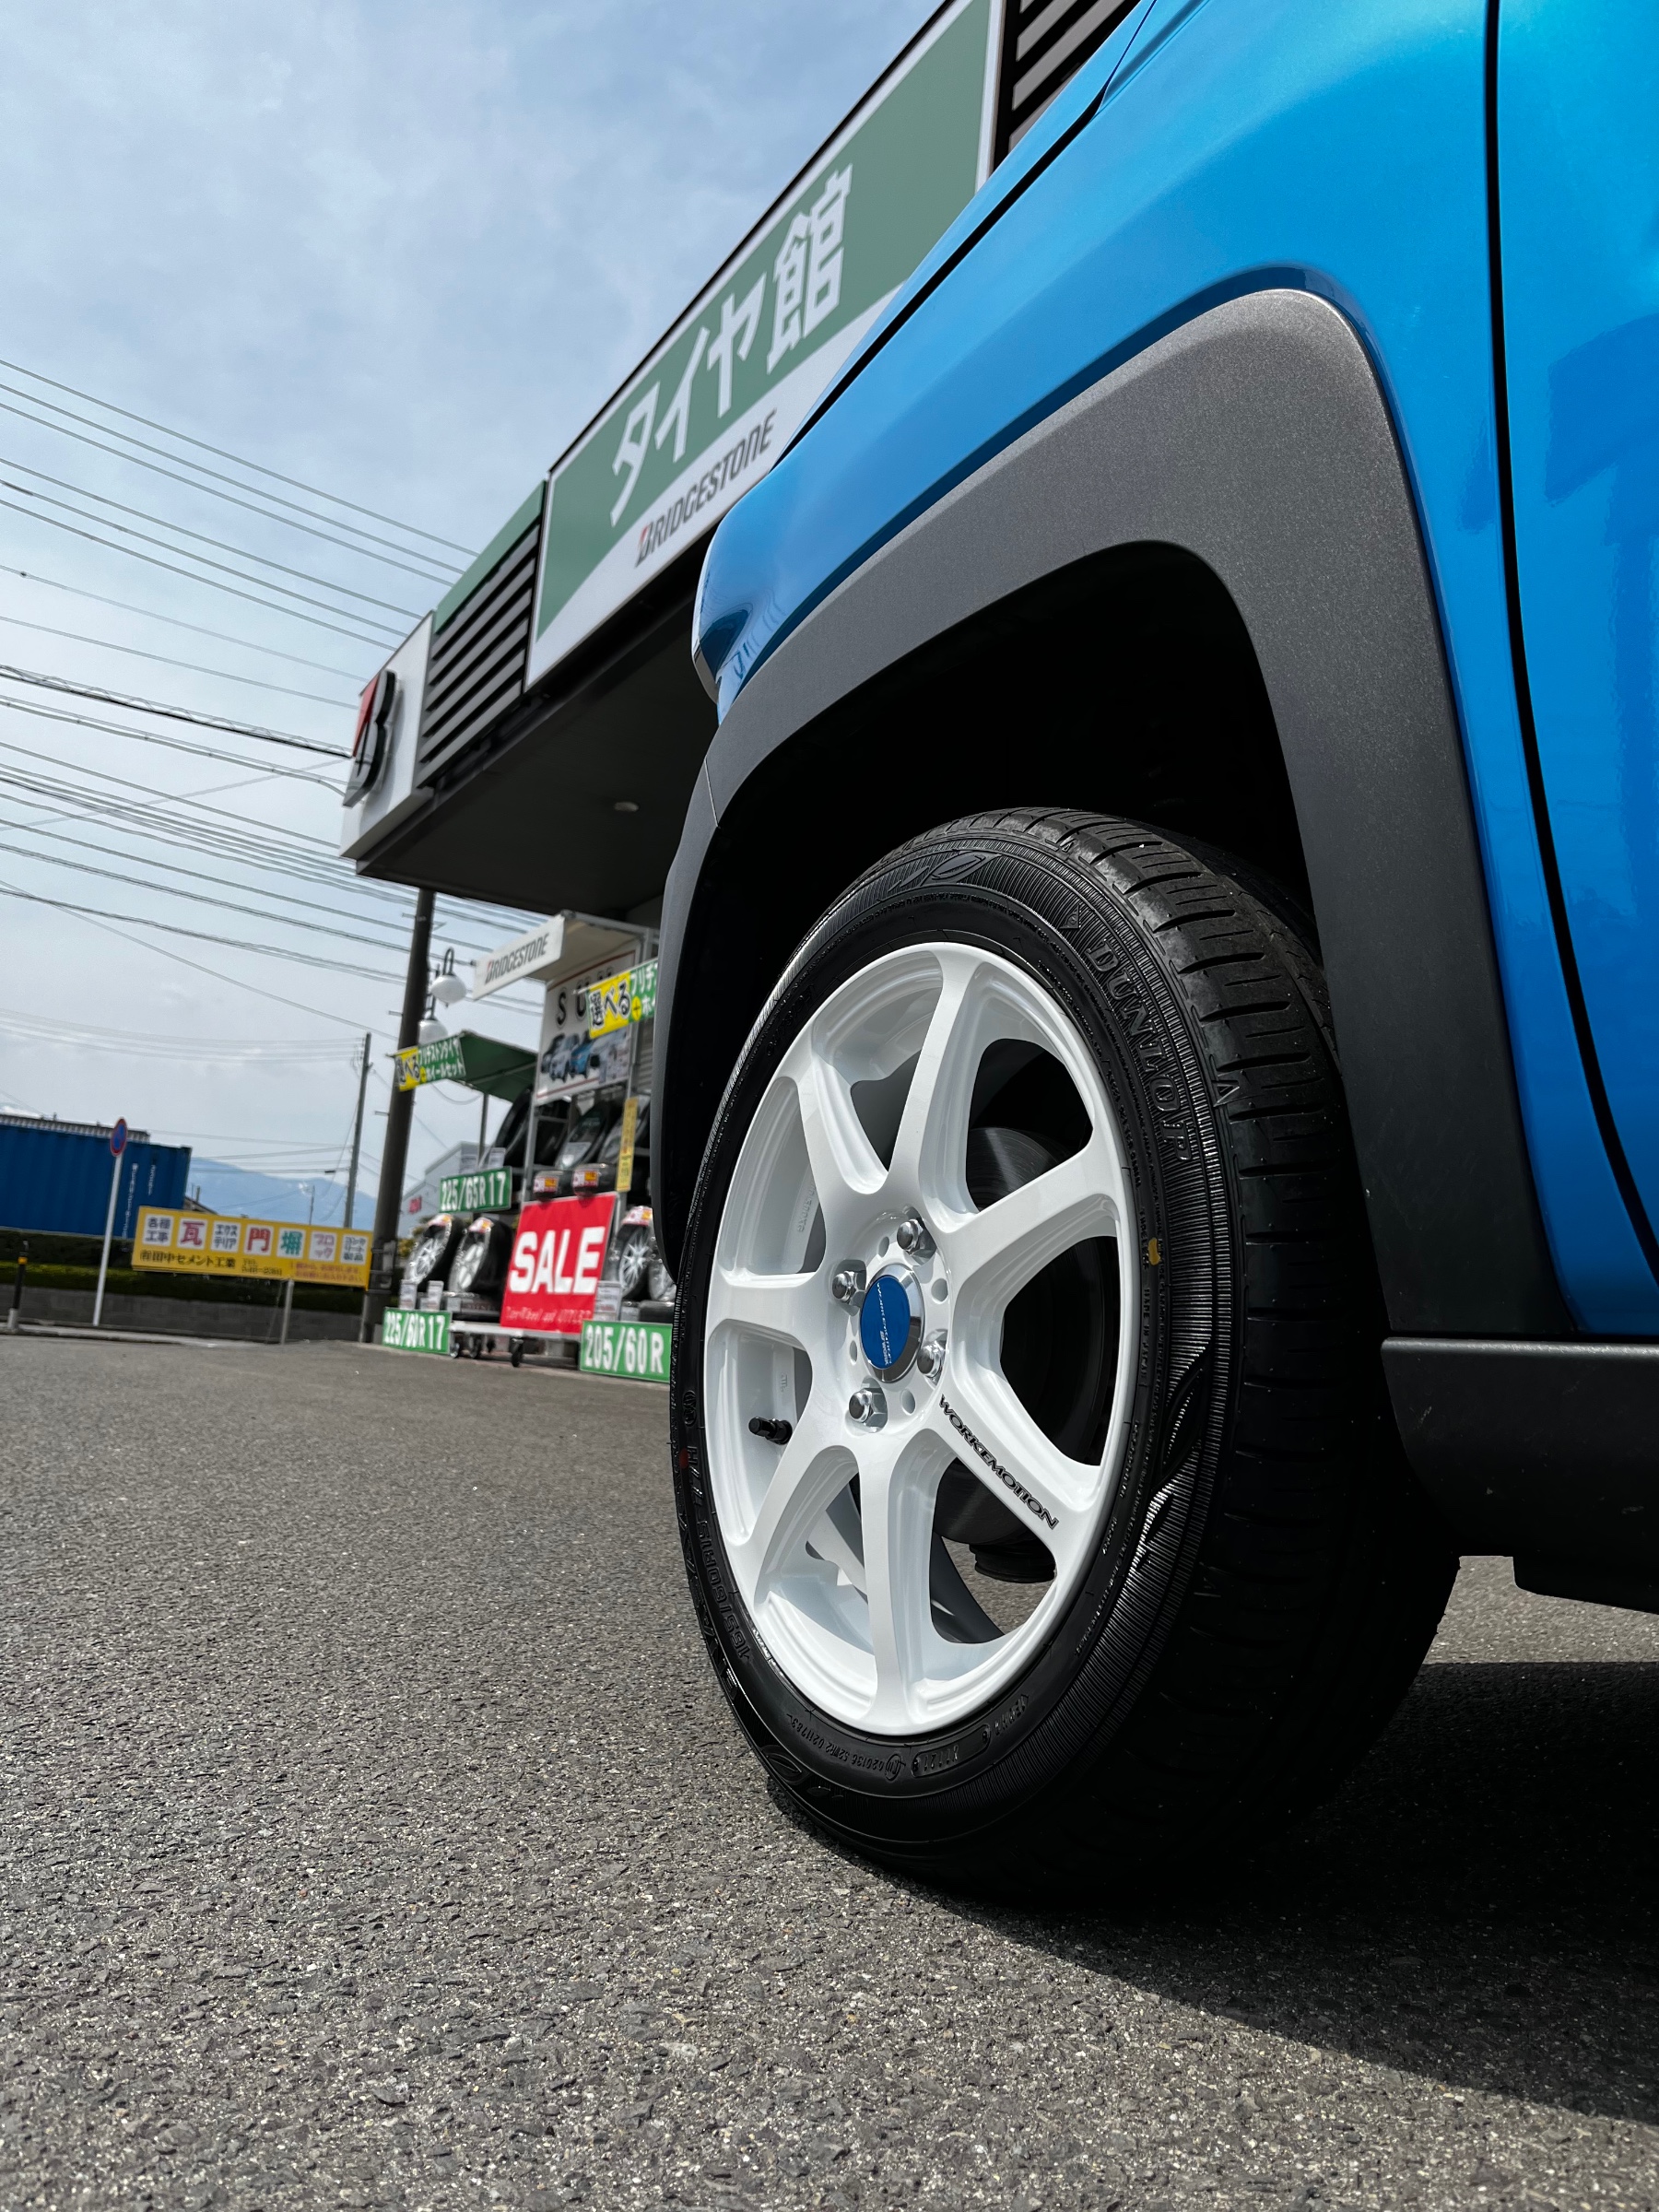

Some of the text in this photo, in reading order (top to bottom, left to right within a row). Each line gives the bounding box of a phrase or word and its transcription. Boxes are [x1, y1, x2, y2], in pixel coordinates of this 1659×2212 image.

[610, 163, 853, 527] タイヤ館
[635, 407, 777, 568] BRIDGESTONE
[485, 933, 550, 985] BRIDGESTONE
[1085, 938, 1193, 1161] DUNLOP
[180, 1221, 205, 1246] 瓦
[247, 1228, 271, 1252] 門
[509, 1227, 606, 1295] SALE
